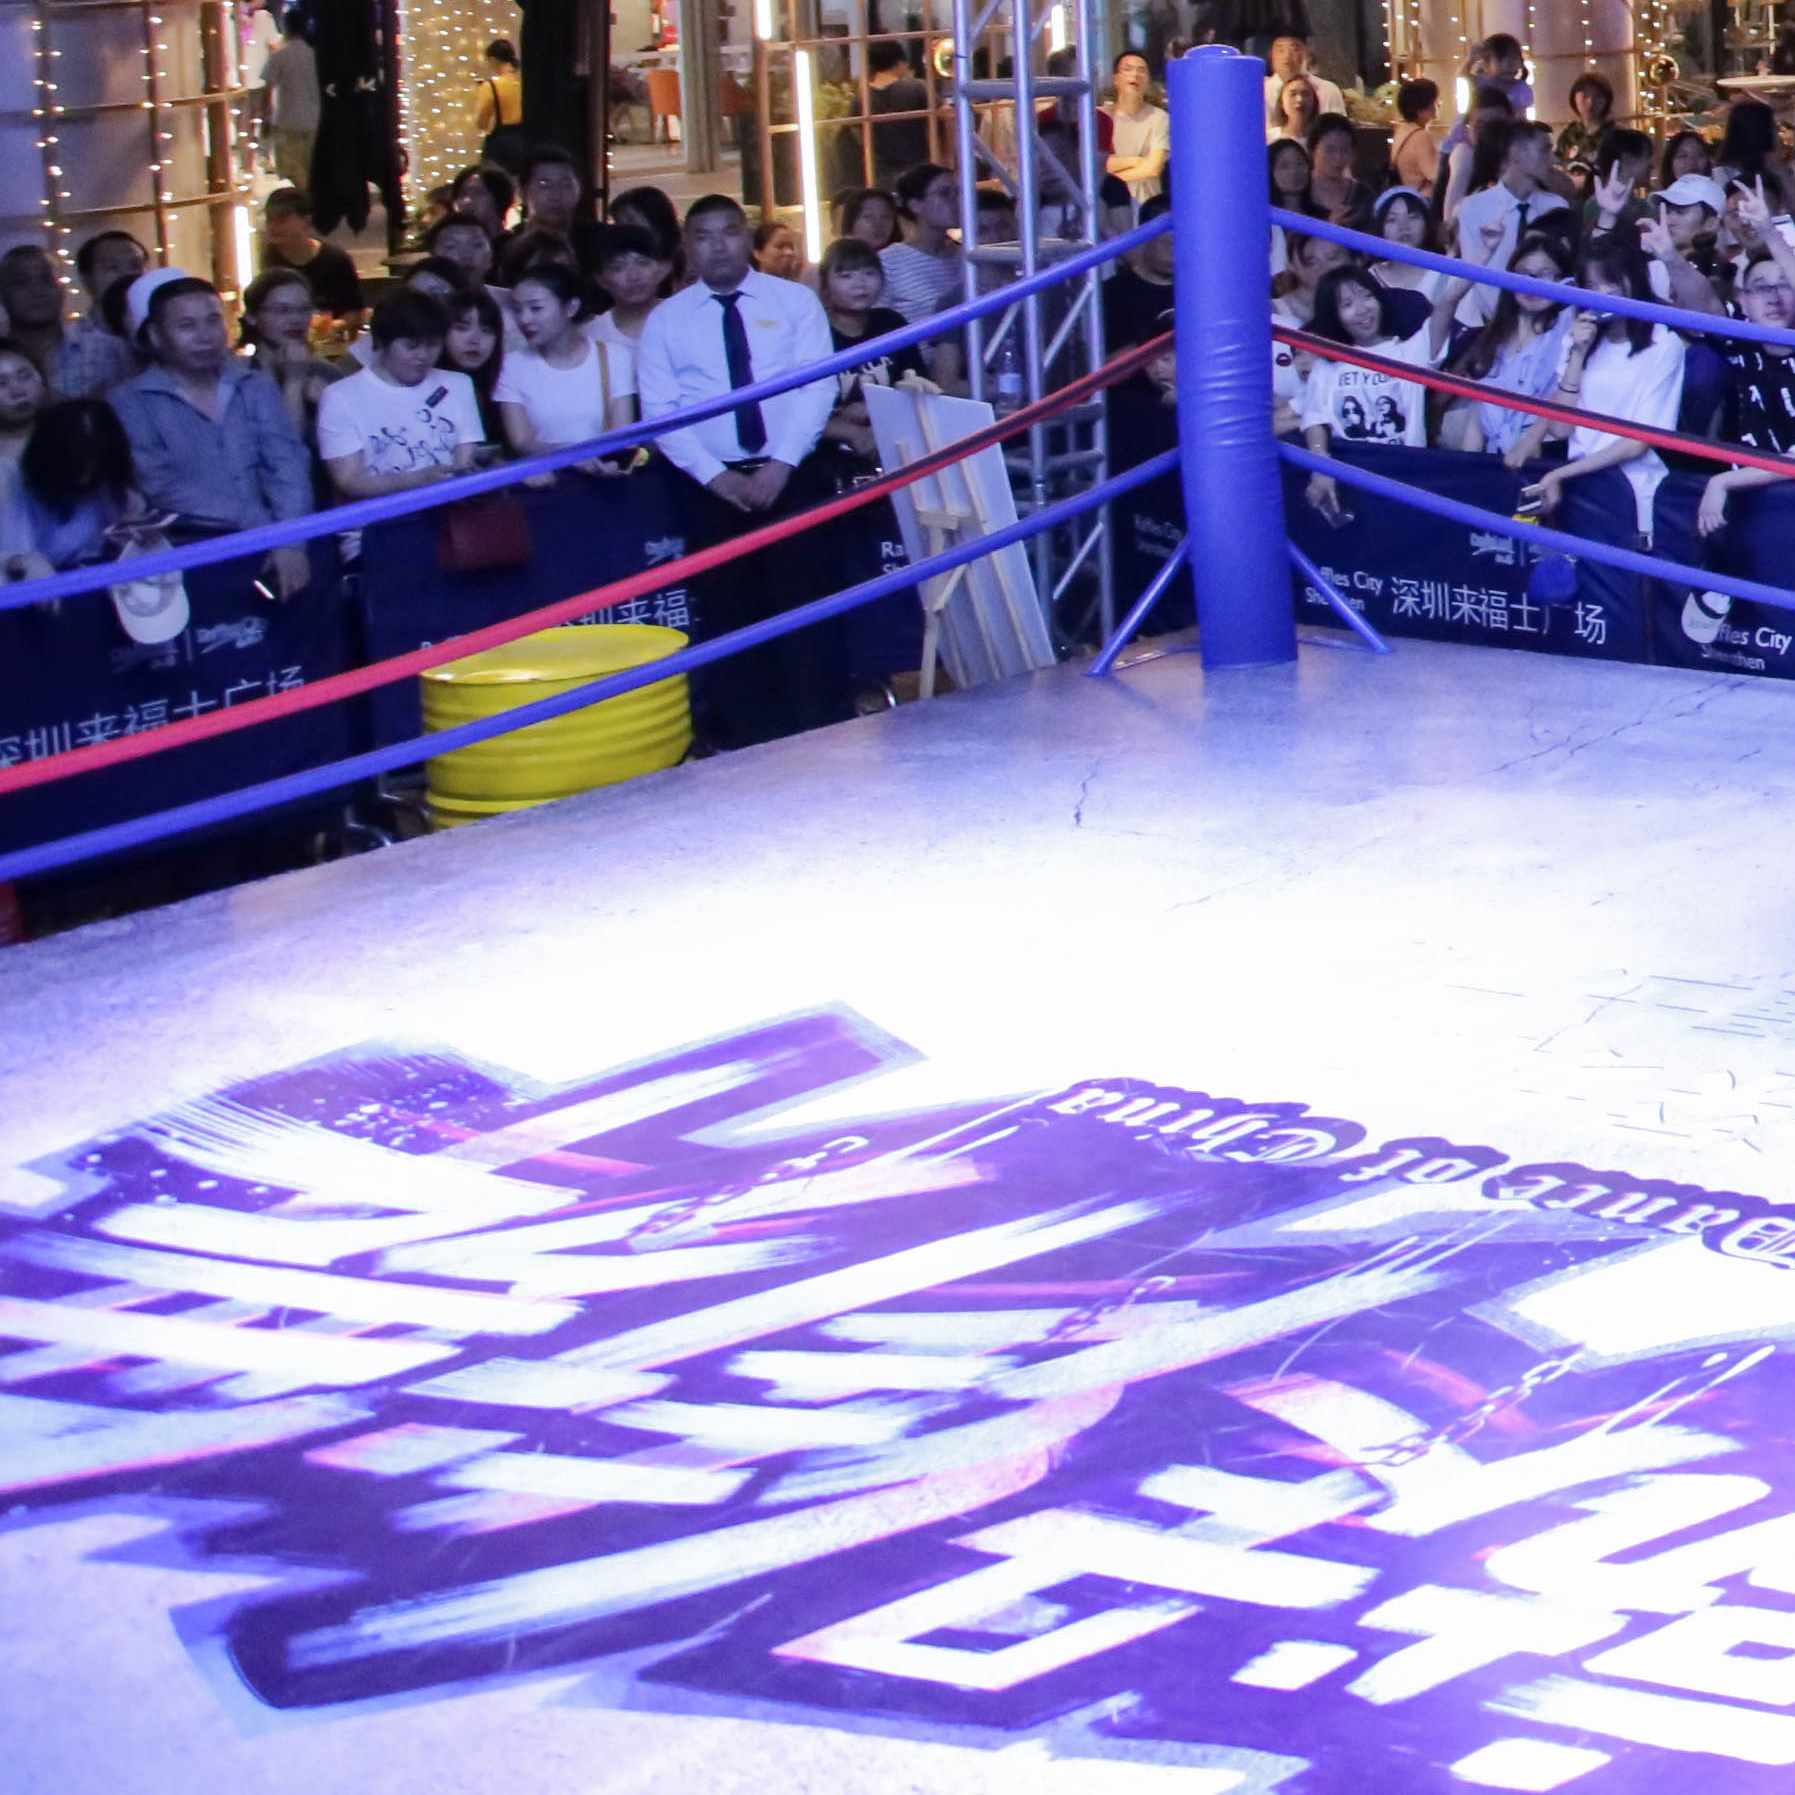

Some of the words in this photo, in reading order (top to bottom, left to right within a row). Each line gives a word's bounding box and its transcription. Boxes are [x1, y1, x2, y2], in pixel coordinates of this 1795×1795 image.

[1353, 570, 1384, 597] City
[1755, 627, 1793, 655] City
[1046, 1076, 1369, 1168] China
[1340, 1135, 1510, 1187] of
